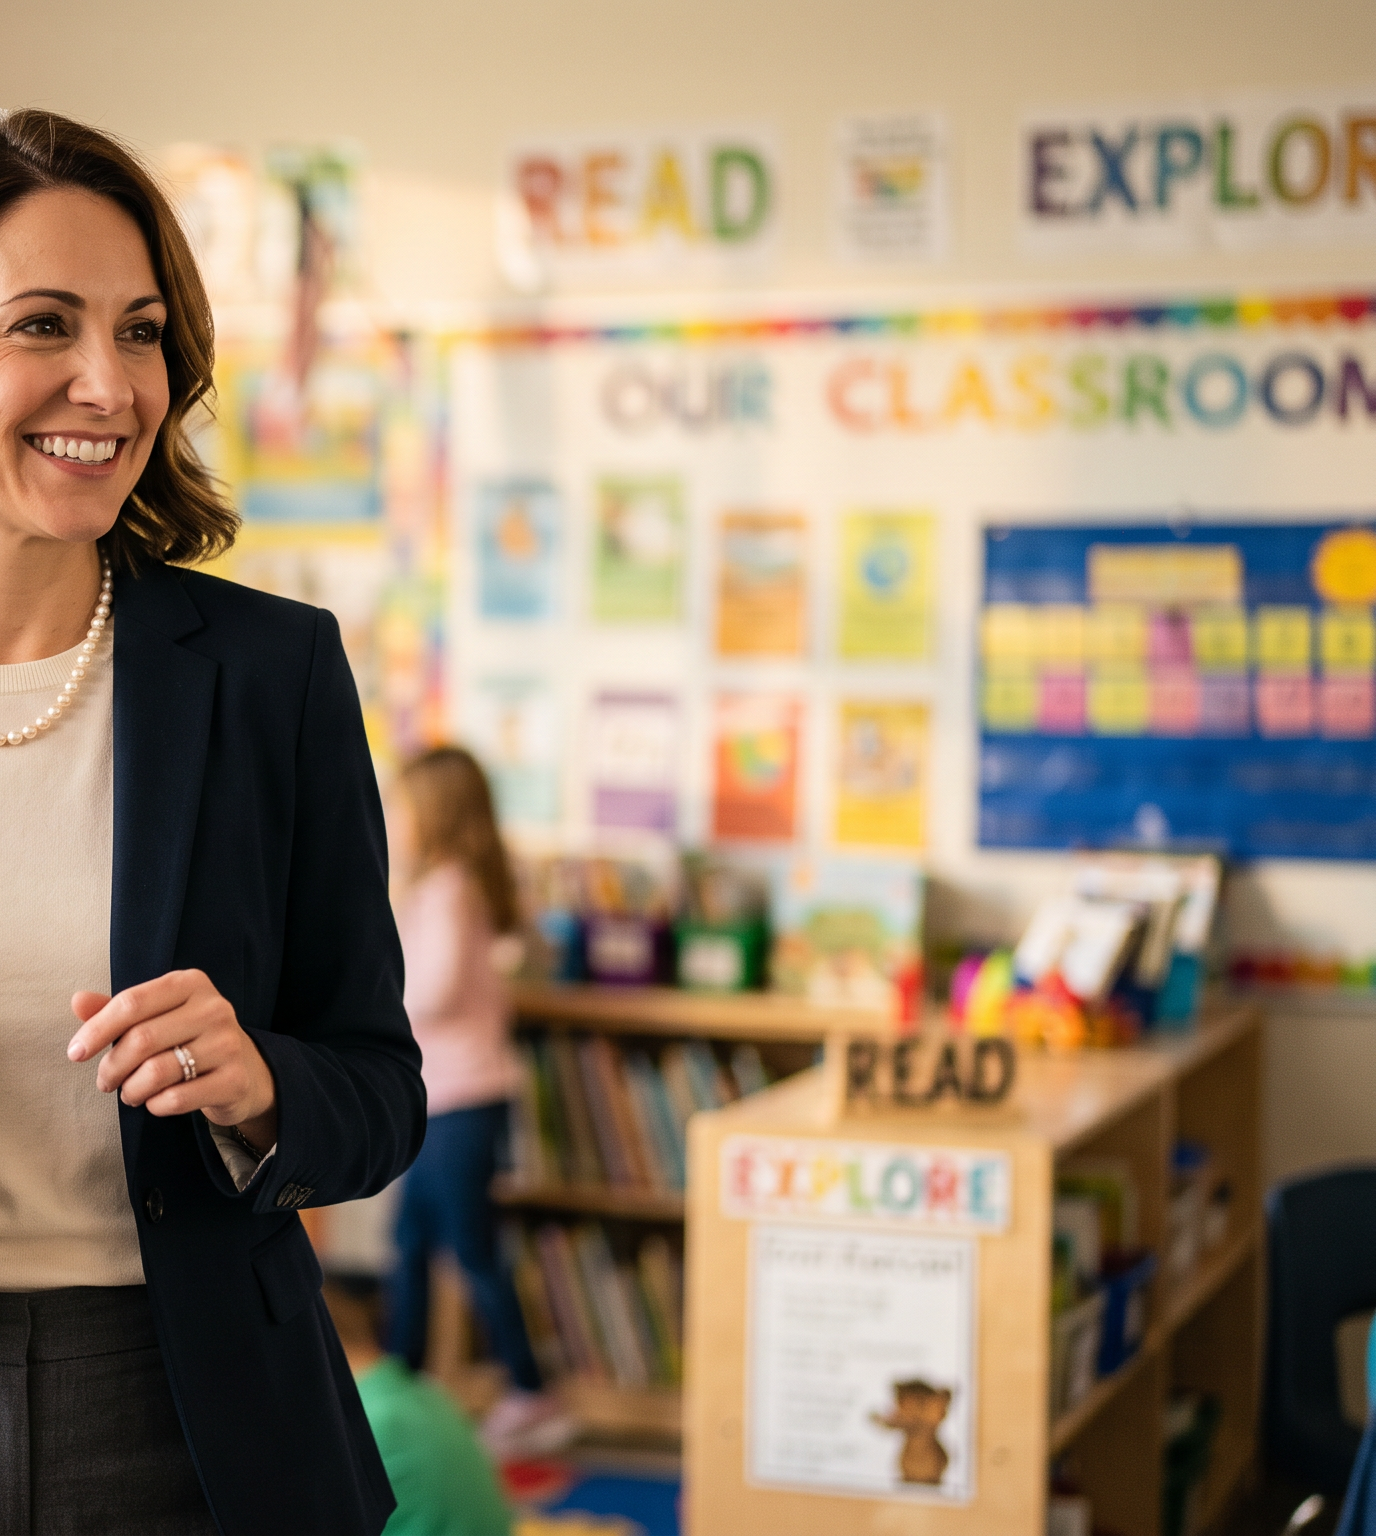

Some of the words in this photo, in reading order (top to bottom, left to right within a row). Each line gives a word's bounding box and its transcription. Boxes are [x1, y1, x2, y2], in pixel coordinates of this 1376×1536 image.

[514, 146, 774, 247] READ
[600, 362, 772, 434] OUR
[845, 1036, 1018, 1108] READ
[730, 1149, 1003, 1223] EXPLORE
